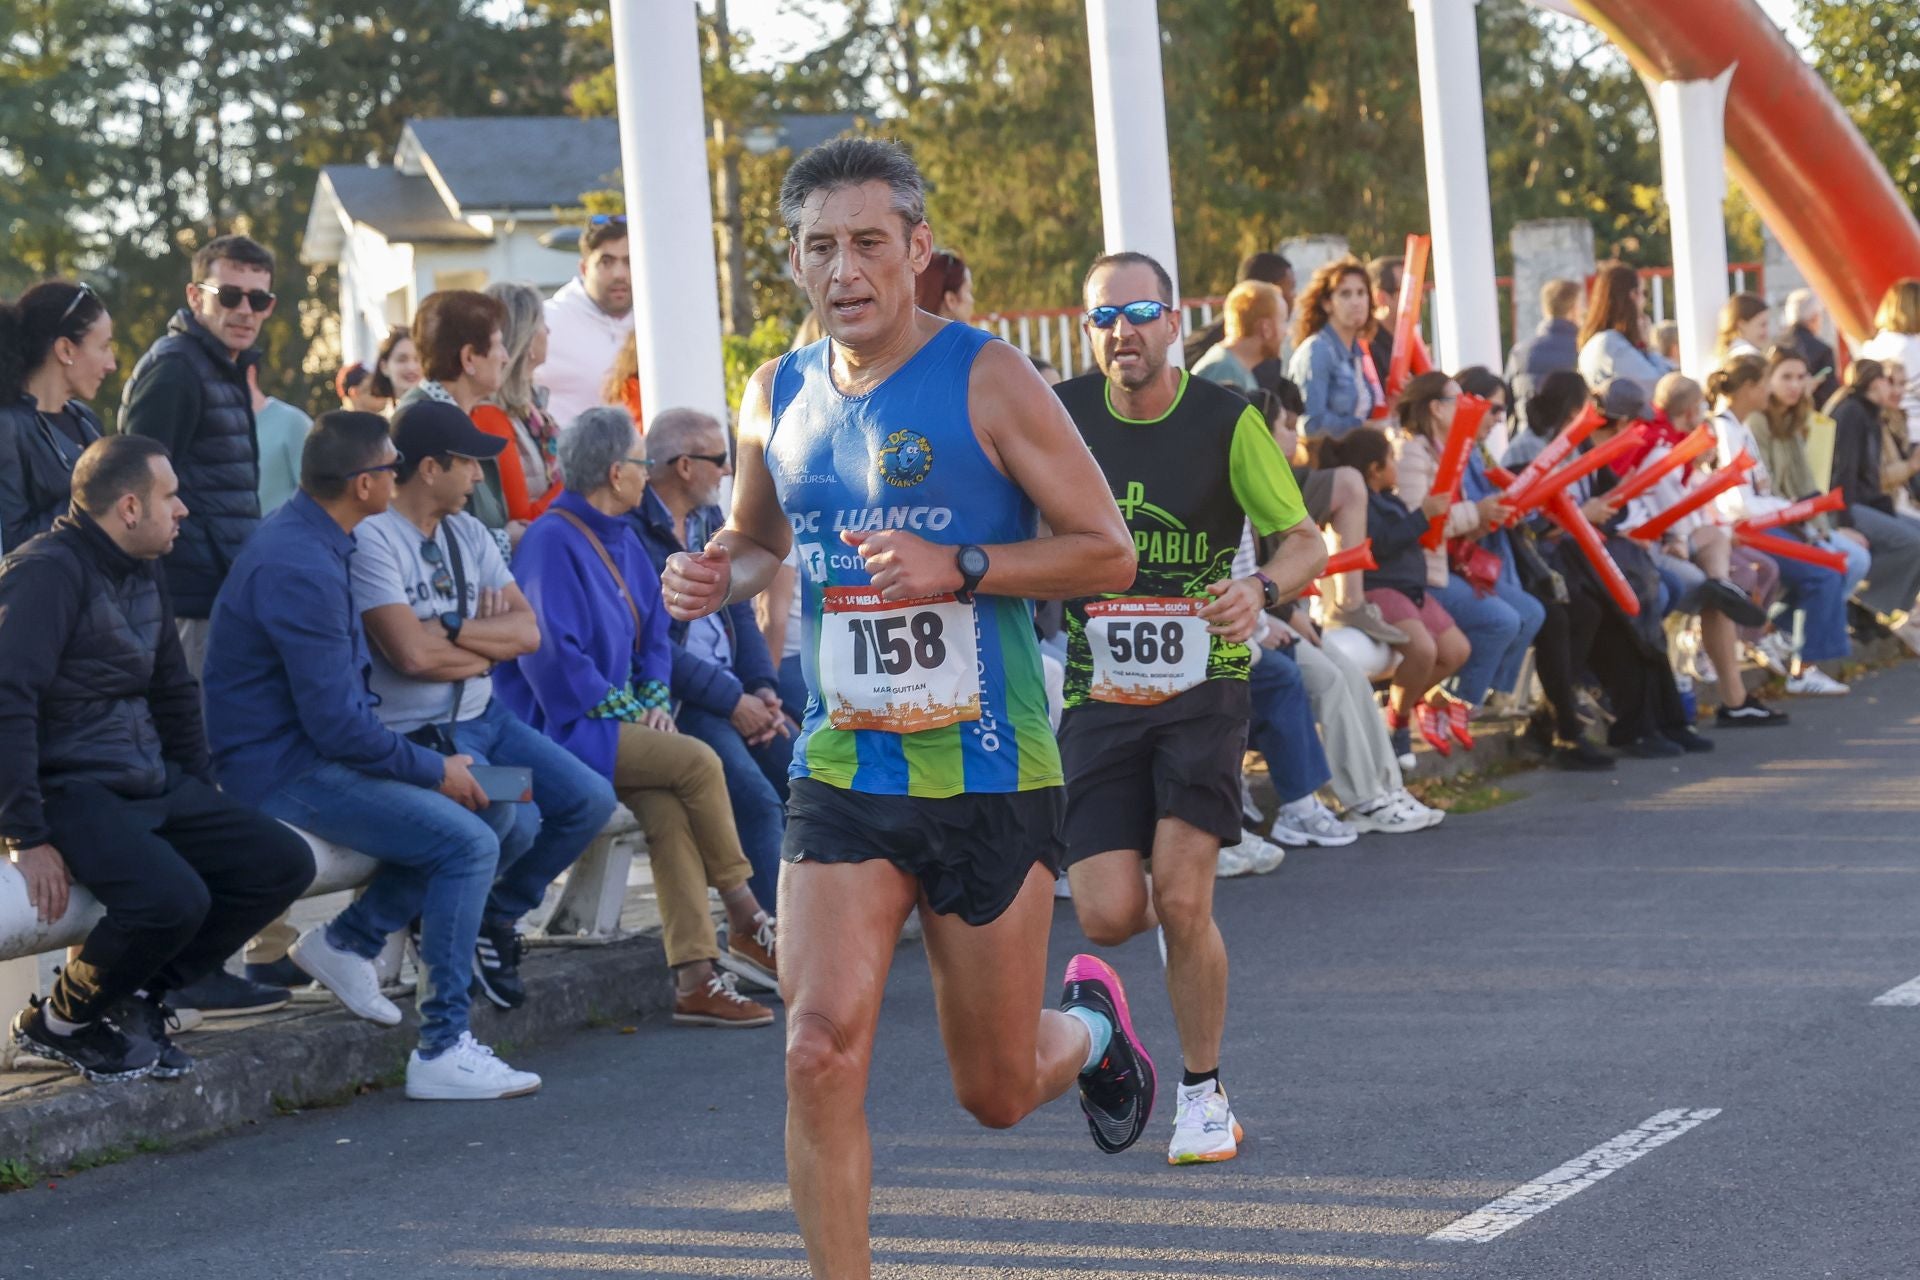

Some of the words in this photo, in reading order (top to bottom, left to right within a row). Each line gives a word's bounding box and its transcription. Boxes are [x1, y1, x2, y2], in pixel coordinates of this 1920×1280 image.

[832, 506, 953, 532] LUANCO
[1134, 530, 1209, 564] PABLO
[848, 611, 946, 675] 1158
[1107, 622, 1184, 665] 568
